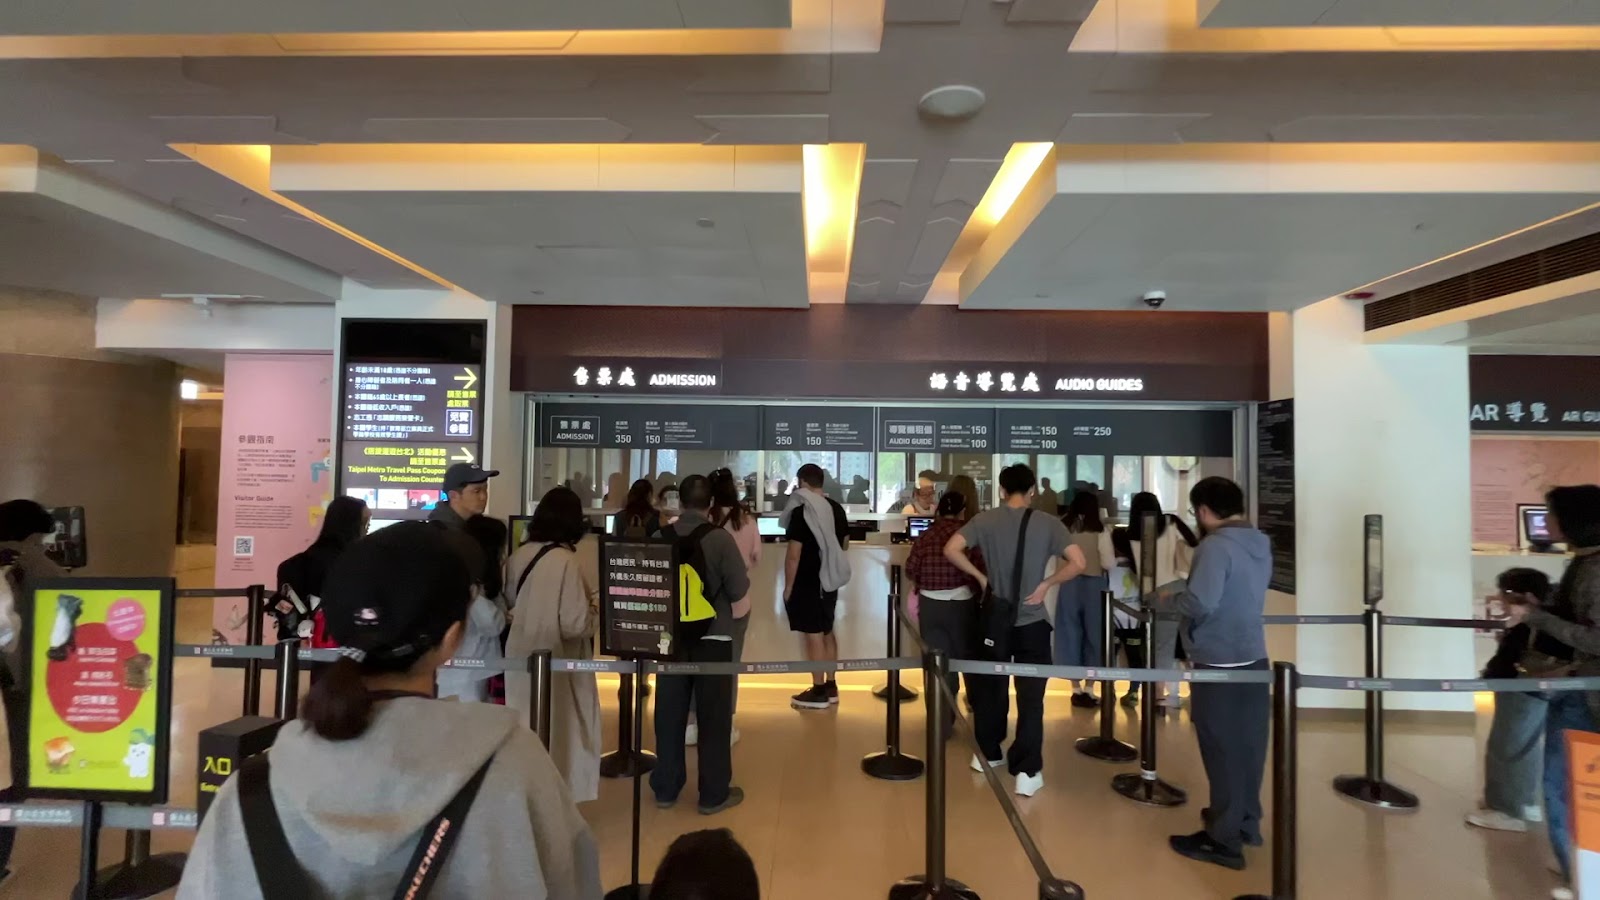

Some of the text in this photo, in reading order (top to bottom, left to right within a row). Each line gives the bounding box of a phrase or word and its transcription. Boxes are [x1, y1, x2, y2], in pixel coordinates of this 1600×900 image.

[573, 366, 716, 386] 售票處 ADMISSION
[930, 371, 1144, 391] 語音導覽處 AUDIO GUIDES
[1470, 403, 1499, 421] AR
[1505, 400, 1549, 422] 導覽
[450, 411, 469, 422] 免費
[971, 426, 987, 435] 150
[1041, 427, 1057, 436] 150
[1094, 427, 1112, 436] 250
[615, 435, 632, 444] 350
[645, 436, 661, 445] 150
[776, 437, 793, 446] 350
[806, 437, 822, 446] 150
[911, 438, 932, 446] GUIDE
[971, 440, 987, 449] 100
[1041, 440, 1057, 449] 100
[348, 466, 367, 474] Taipei
[388, 475, 420, 483] Admission
[204, 756, 231, 775] 入口
